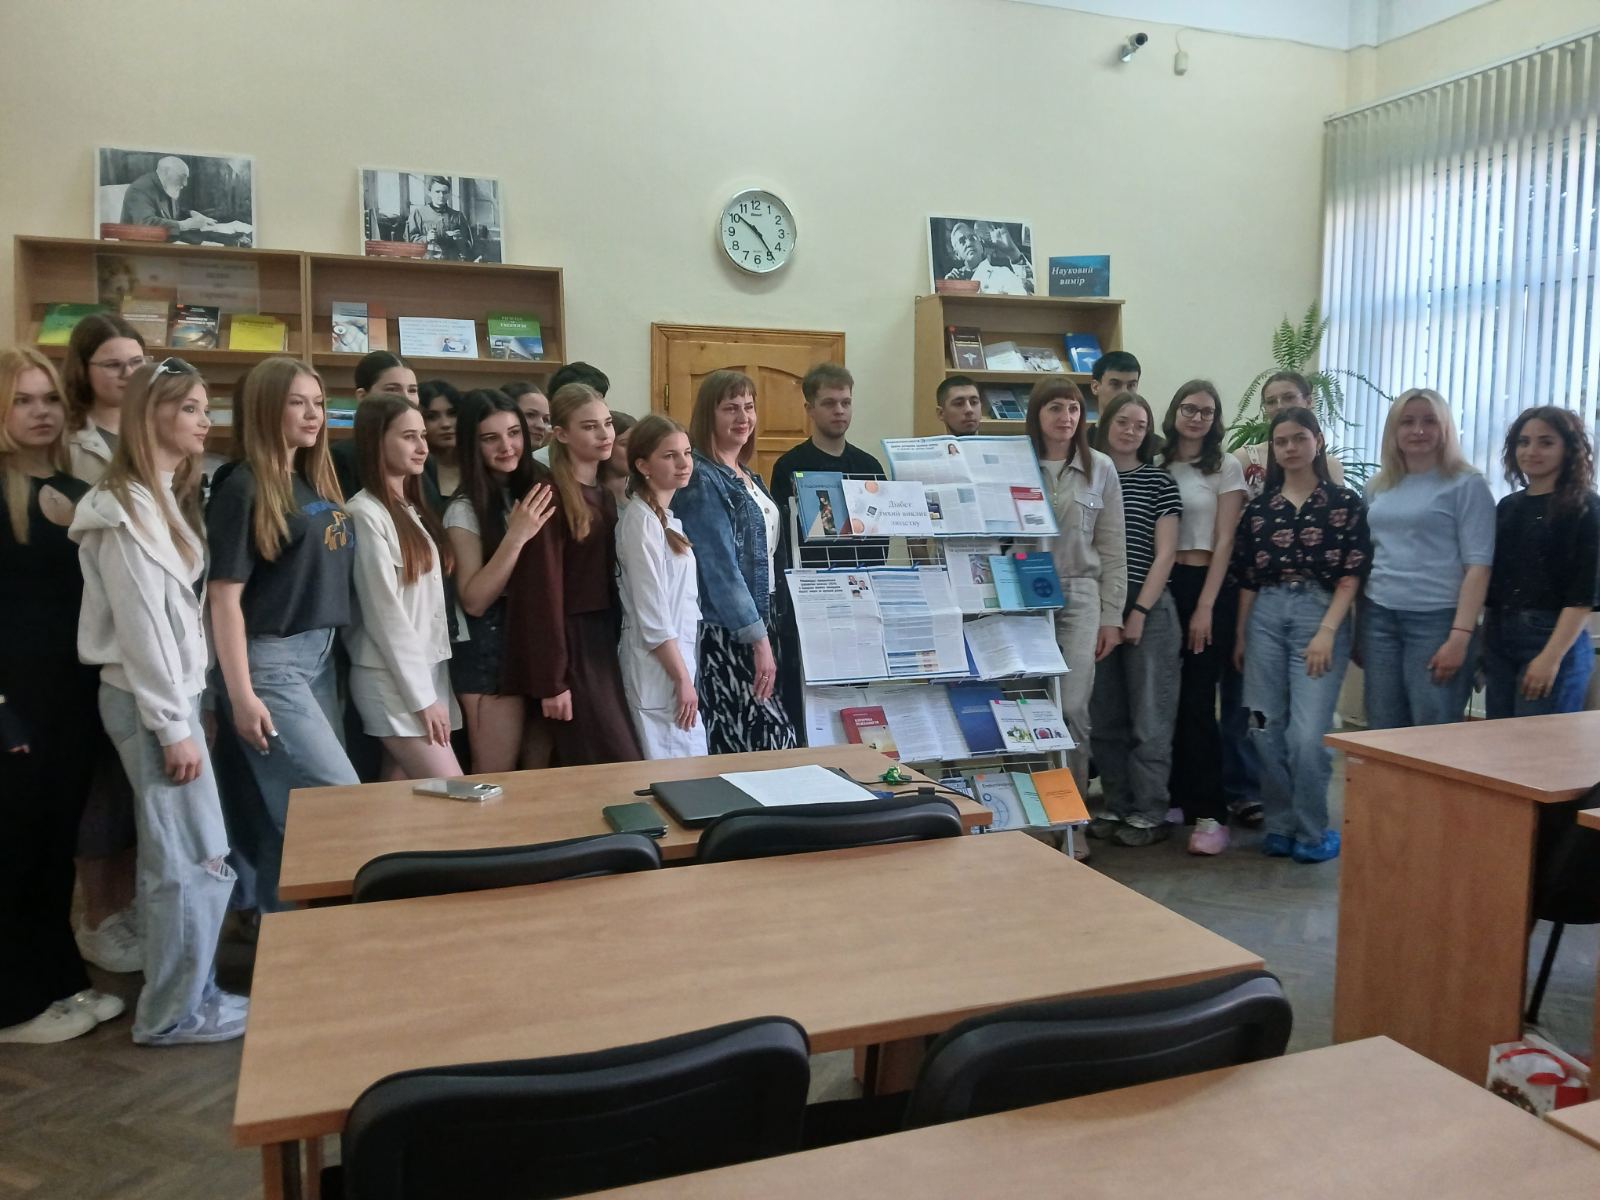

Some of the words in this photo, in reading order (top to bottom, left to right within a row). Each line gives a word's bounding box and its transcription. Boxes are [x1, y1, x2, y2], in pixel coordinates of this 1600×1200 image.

[740, 203, 748, 214] 11
[751, 200, 761, 210] 12
[767, 205, 772, 215] 1
[729, 213, 741, 223] 10
[775, 215, 782, 226] 2
[728, 226, 736, 237] 9
[778, 229, 785, 239] 3
[732, 240, 740, 250] 8
[774, 242, 782, 252] 4
[743, 251, 750, 260] 7
[754, 255, 762, 265] 6
[766, 251, 774, 261] 5
[1051, 266, 1094, 276] Науковий
[1059, 277, 1085, 286] вимір
